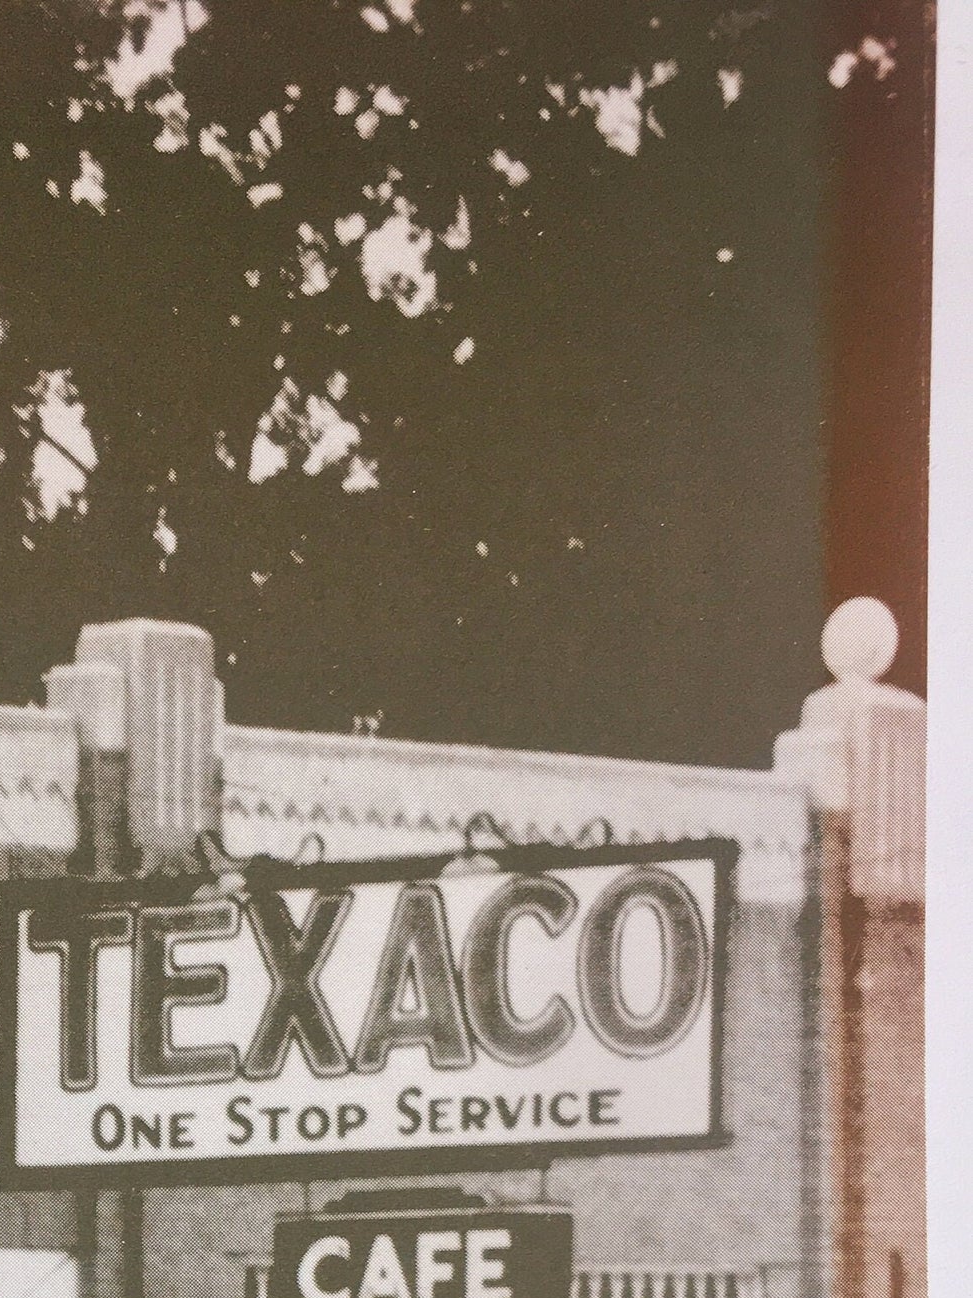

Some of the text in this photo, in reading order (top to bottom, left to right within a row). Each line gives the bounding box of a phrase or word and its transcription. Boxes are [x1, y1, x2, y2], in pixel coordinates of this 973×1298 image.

[27, 866, 709, 1093] TEXACO
[91, 1085, 622, 1151] ONE STOP SERVICE
